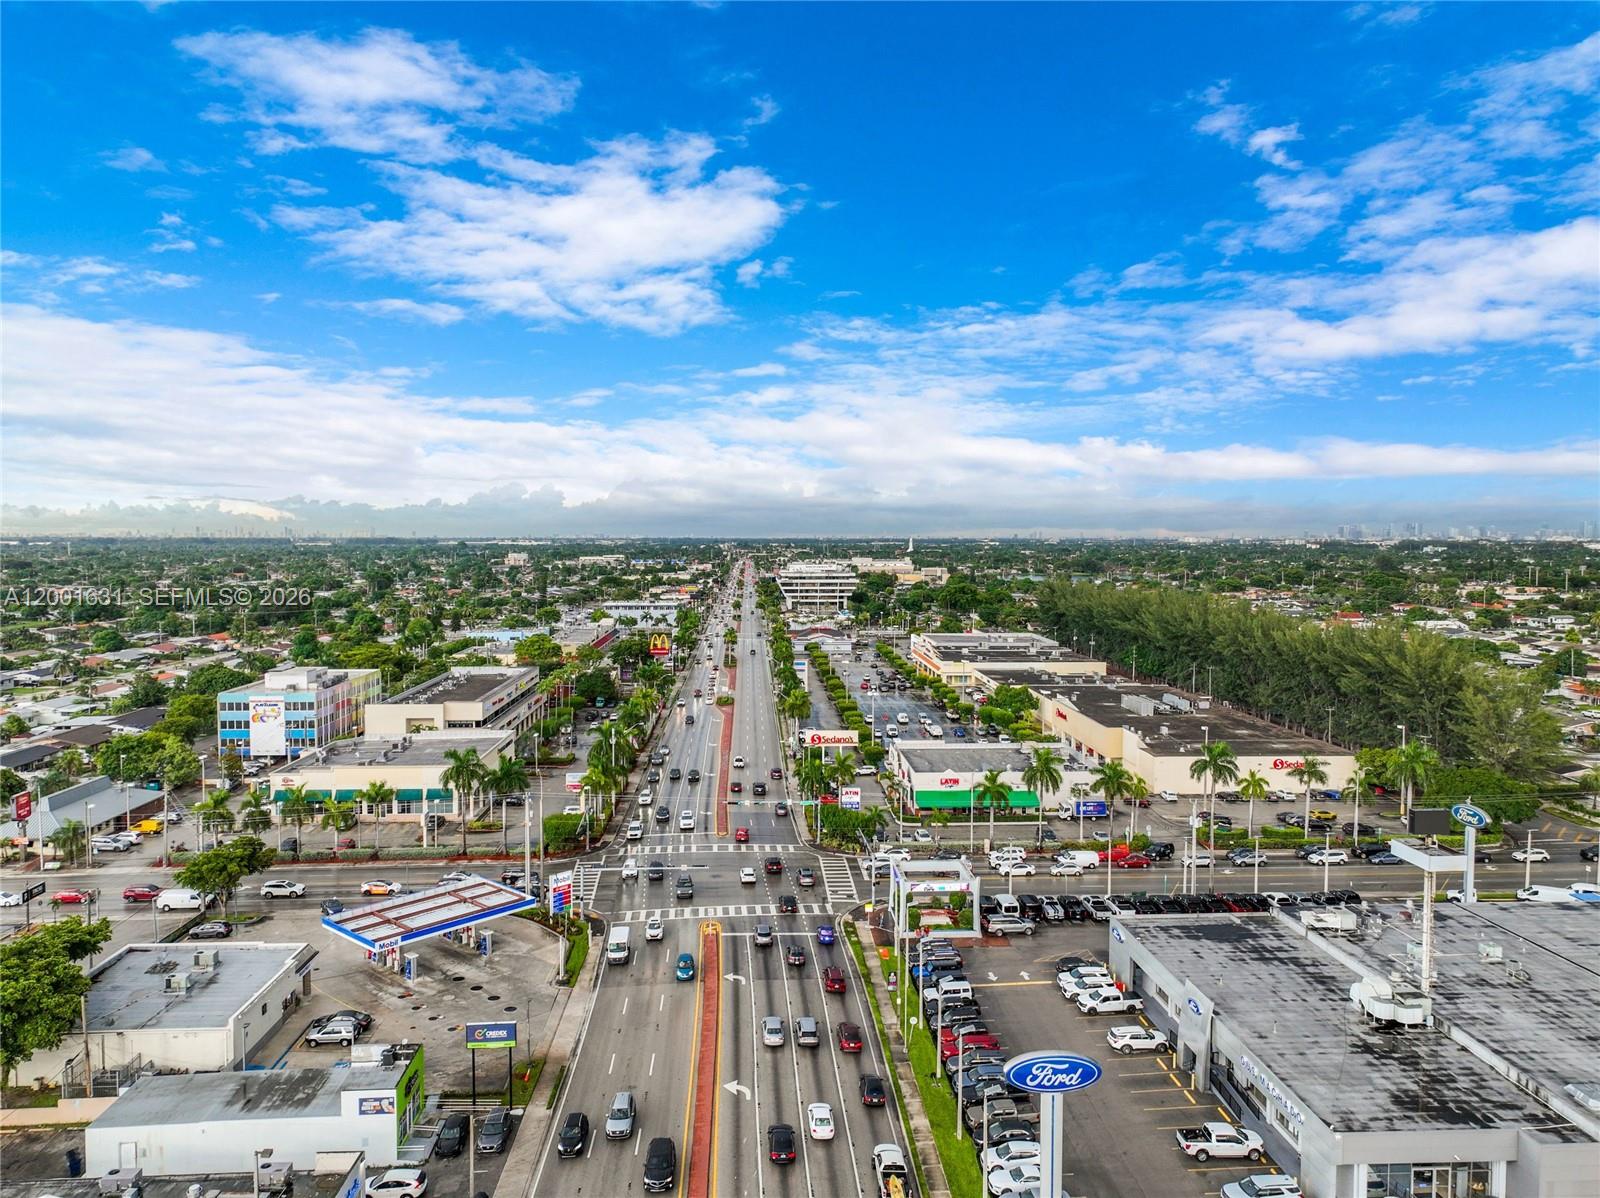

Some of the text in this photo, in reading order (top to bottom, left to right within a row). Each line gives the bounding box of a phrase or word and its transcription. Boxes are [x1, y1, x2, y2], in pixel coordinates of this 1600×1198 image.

[821, 735, 854, 744] Sedano's
[940, 777, 960, 786] LATIN
[1457, 807, 1479, 824] Ford
[378, 938, 399, 951] Mobil
[1026, 1062, 1083, 1087] Ford
